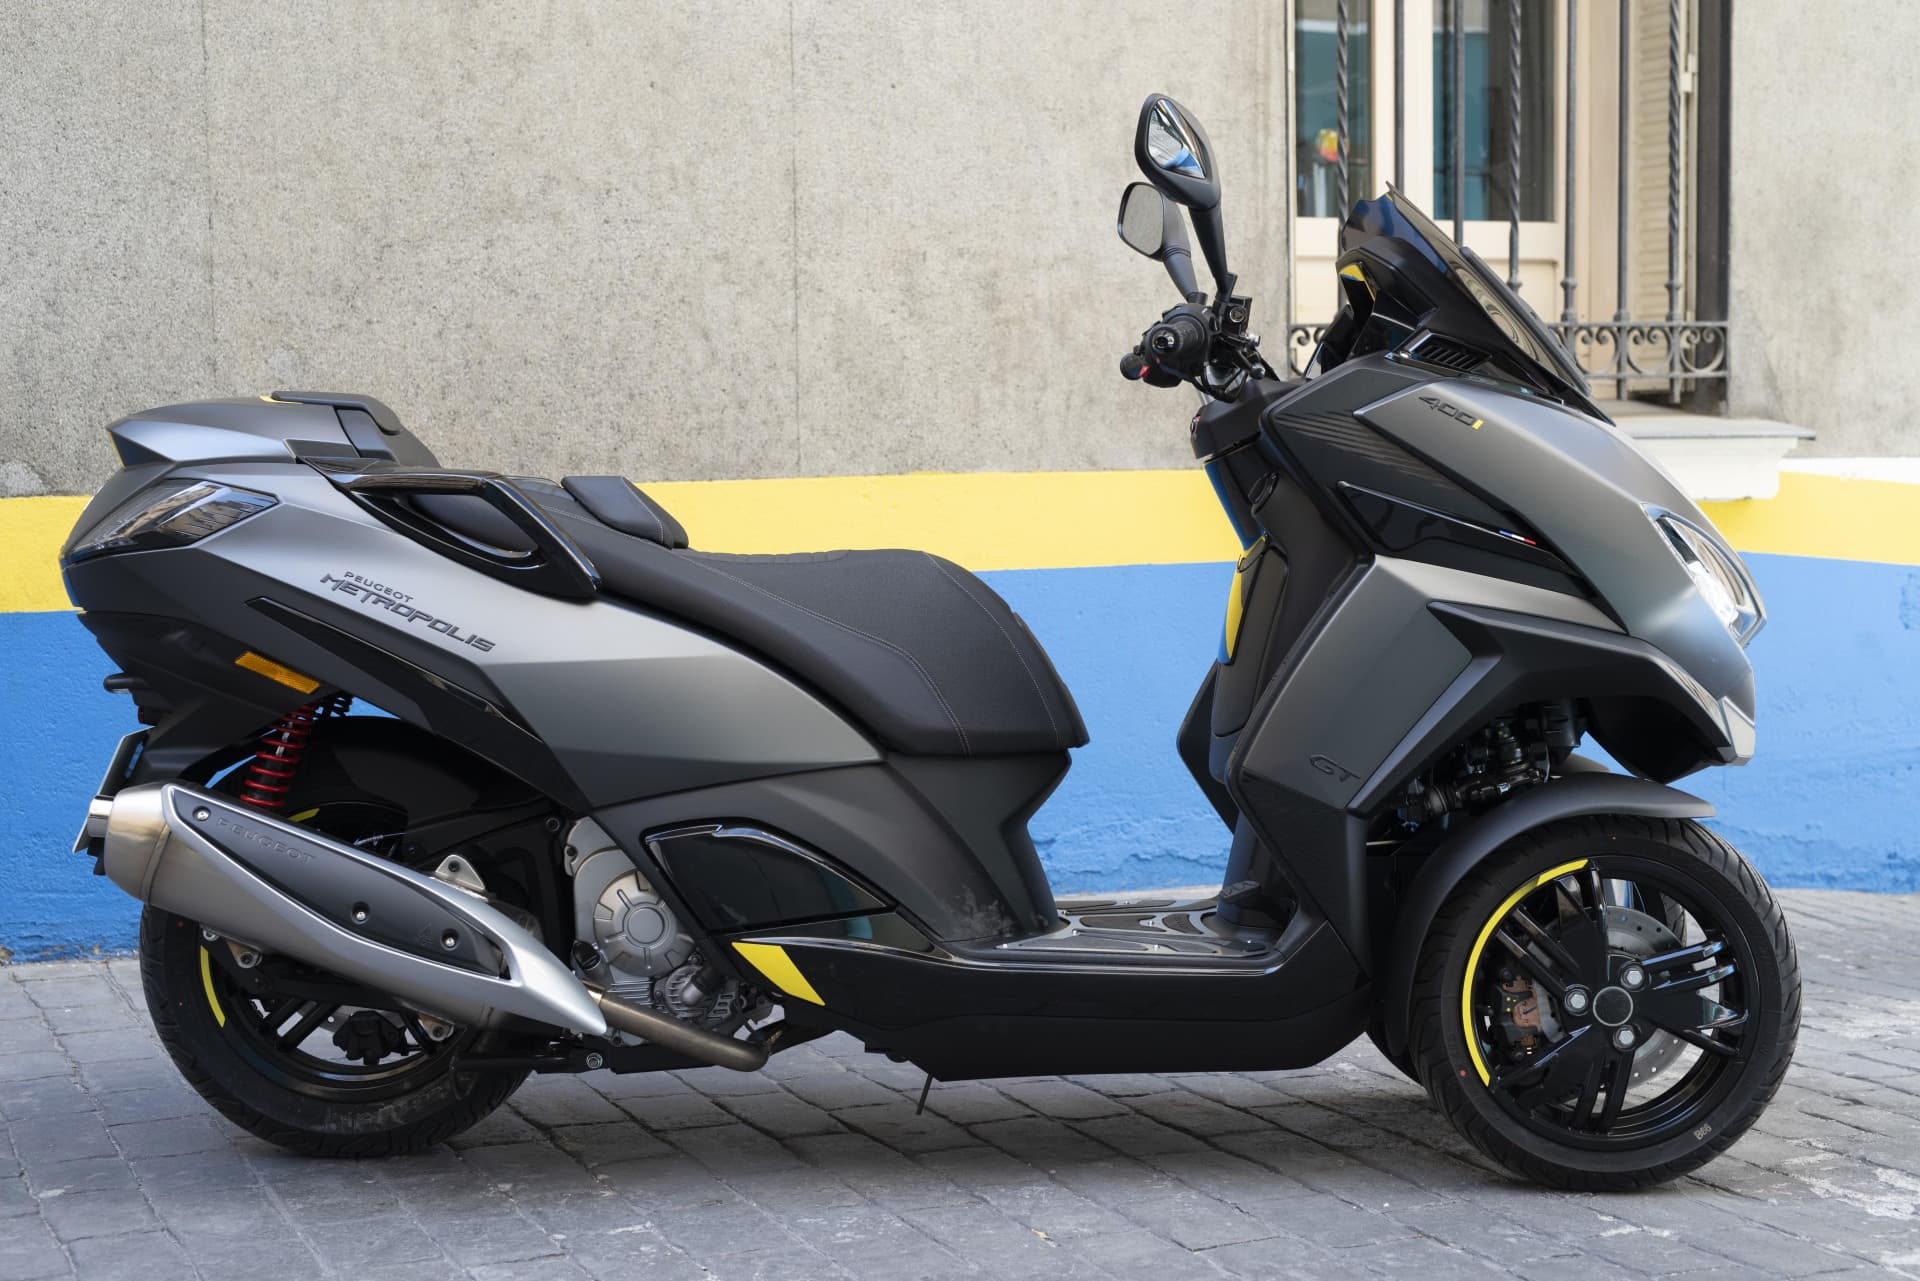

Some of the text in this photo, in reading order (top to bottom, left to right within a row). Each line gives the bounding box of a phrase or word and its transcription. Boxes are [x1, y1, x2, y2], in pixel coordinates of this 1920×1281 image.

[344, 571, 414, 602] PEUGEOT
[320, 573, 496, 652] METROPOLIS
[1309, 754, 1361, 782] GT
[218, 818, 316, 864] PEUGEOT
